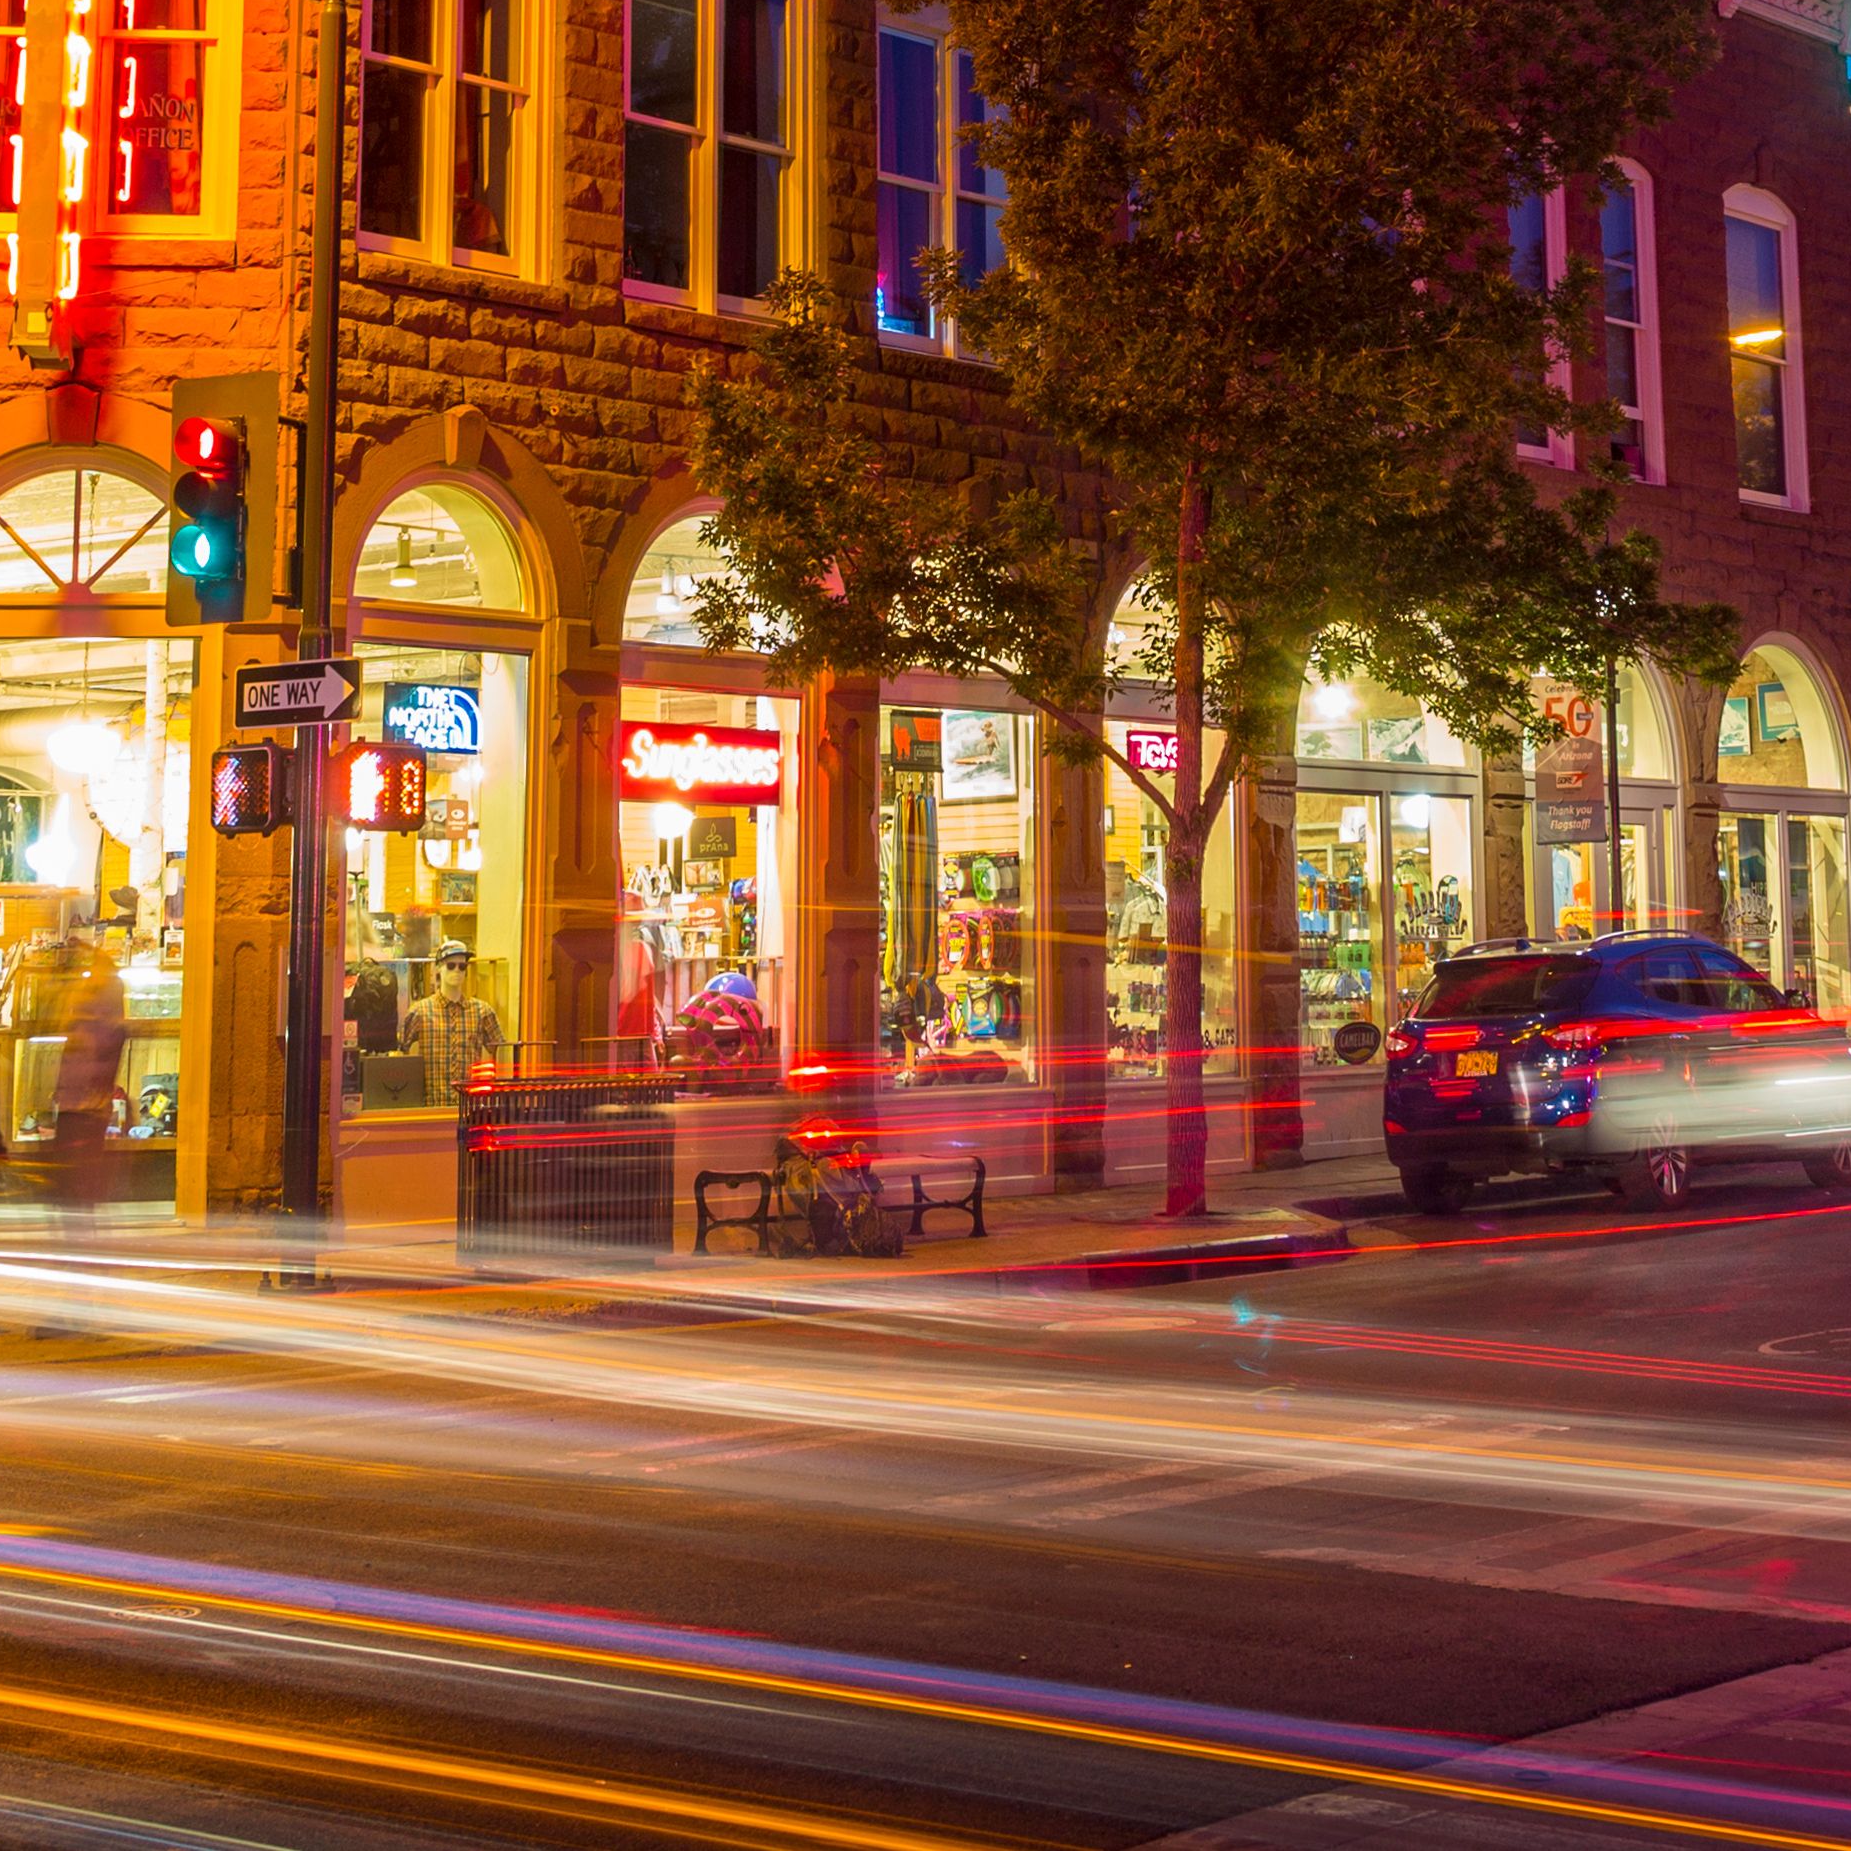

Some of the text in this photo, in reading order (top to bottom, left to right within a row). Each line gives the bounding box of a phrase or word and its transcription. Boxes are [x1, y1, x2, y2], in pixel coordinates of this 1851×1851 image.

[133, 92, 196, 123] AÑON
[248, 680, 322, 709] ONE WAY
[1545, 697, 1592, 737] 50
[622, 729, 780, 791] Sunglasses
[1548, 805, 1593, 818] Thank you
[1550, 817, 1591, 831] Flagstaff!
[1215, 1028, 1236, 1045] CAPS
